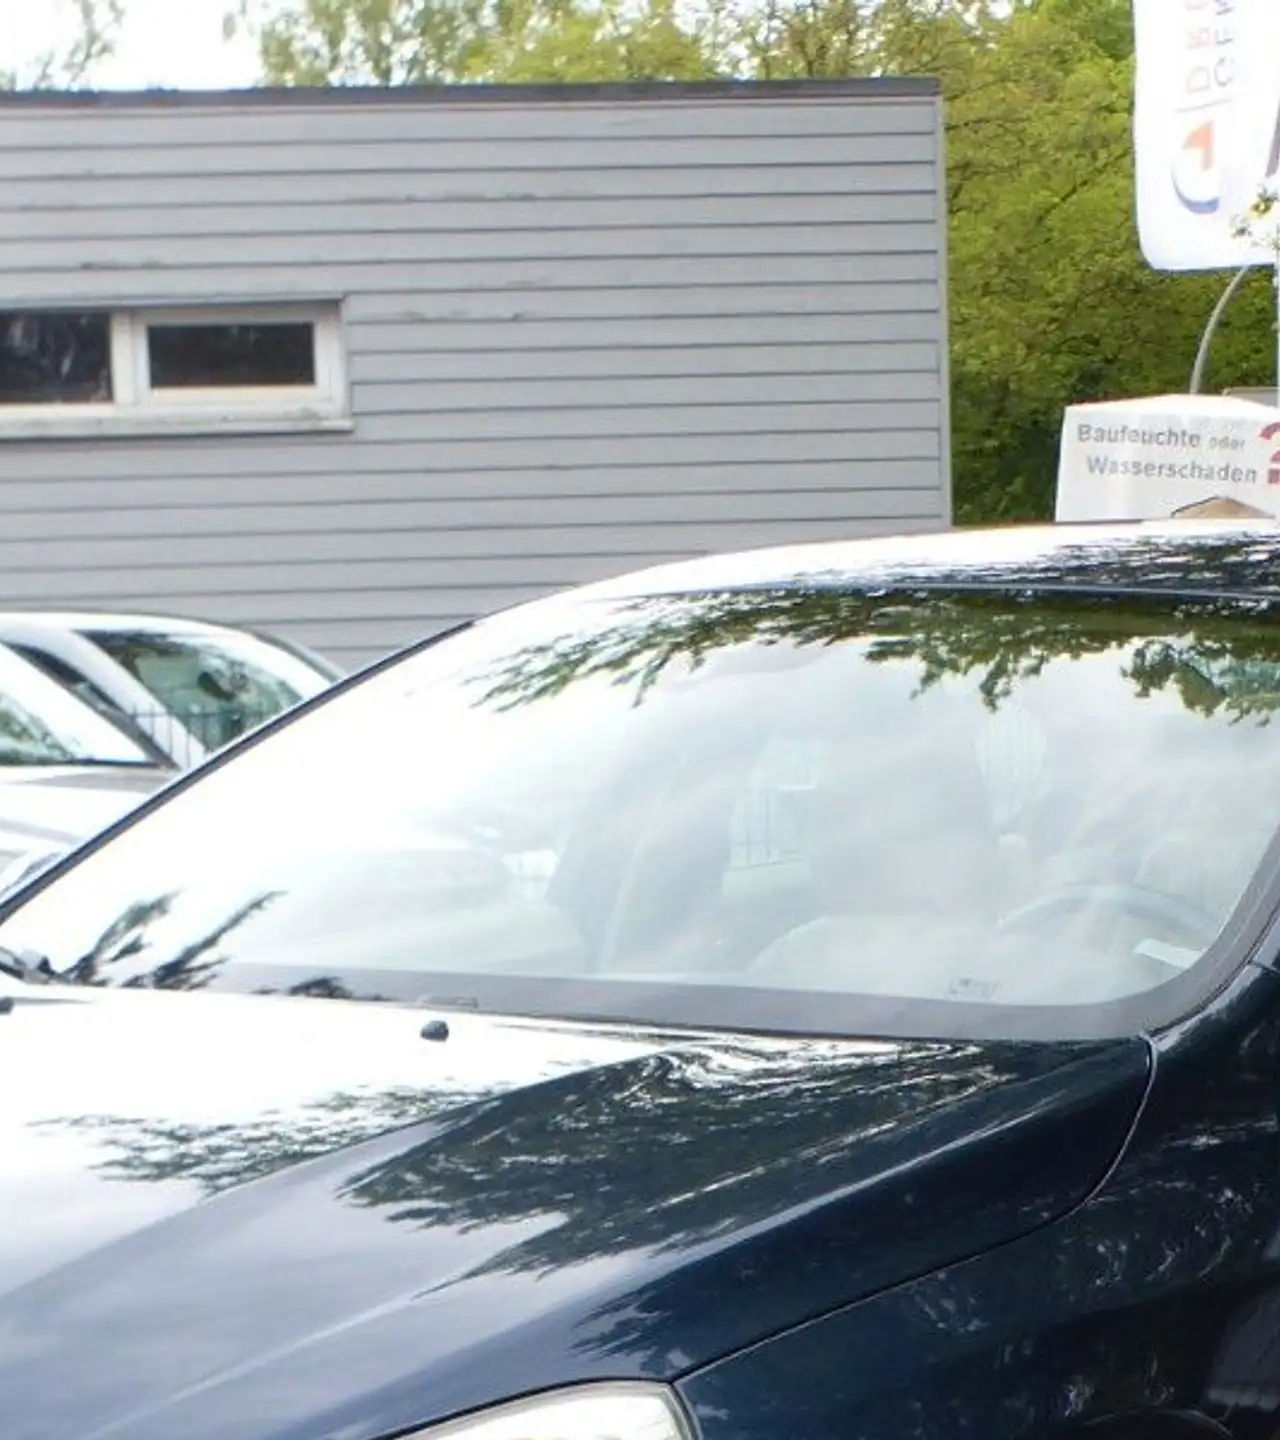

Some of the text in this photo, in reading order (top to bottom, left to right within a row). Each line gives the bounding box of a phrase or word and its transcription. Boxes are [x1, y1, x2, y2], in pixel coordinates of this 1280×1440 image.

[1076, 423, 1246, 450] Baufeuchte oder
[1086, 454, 1258, 485] Wasserschaden
